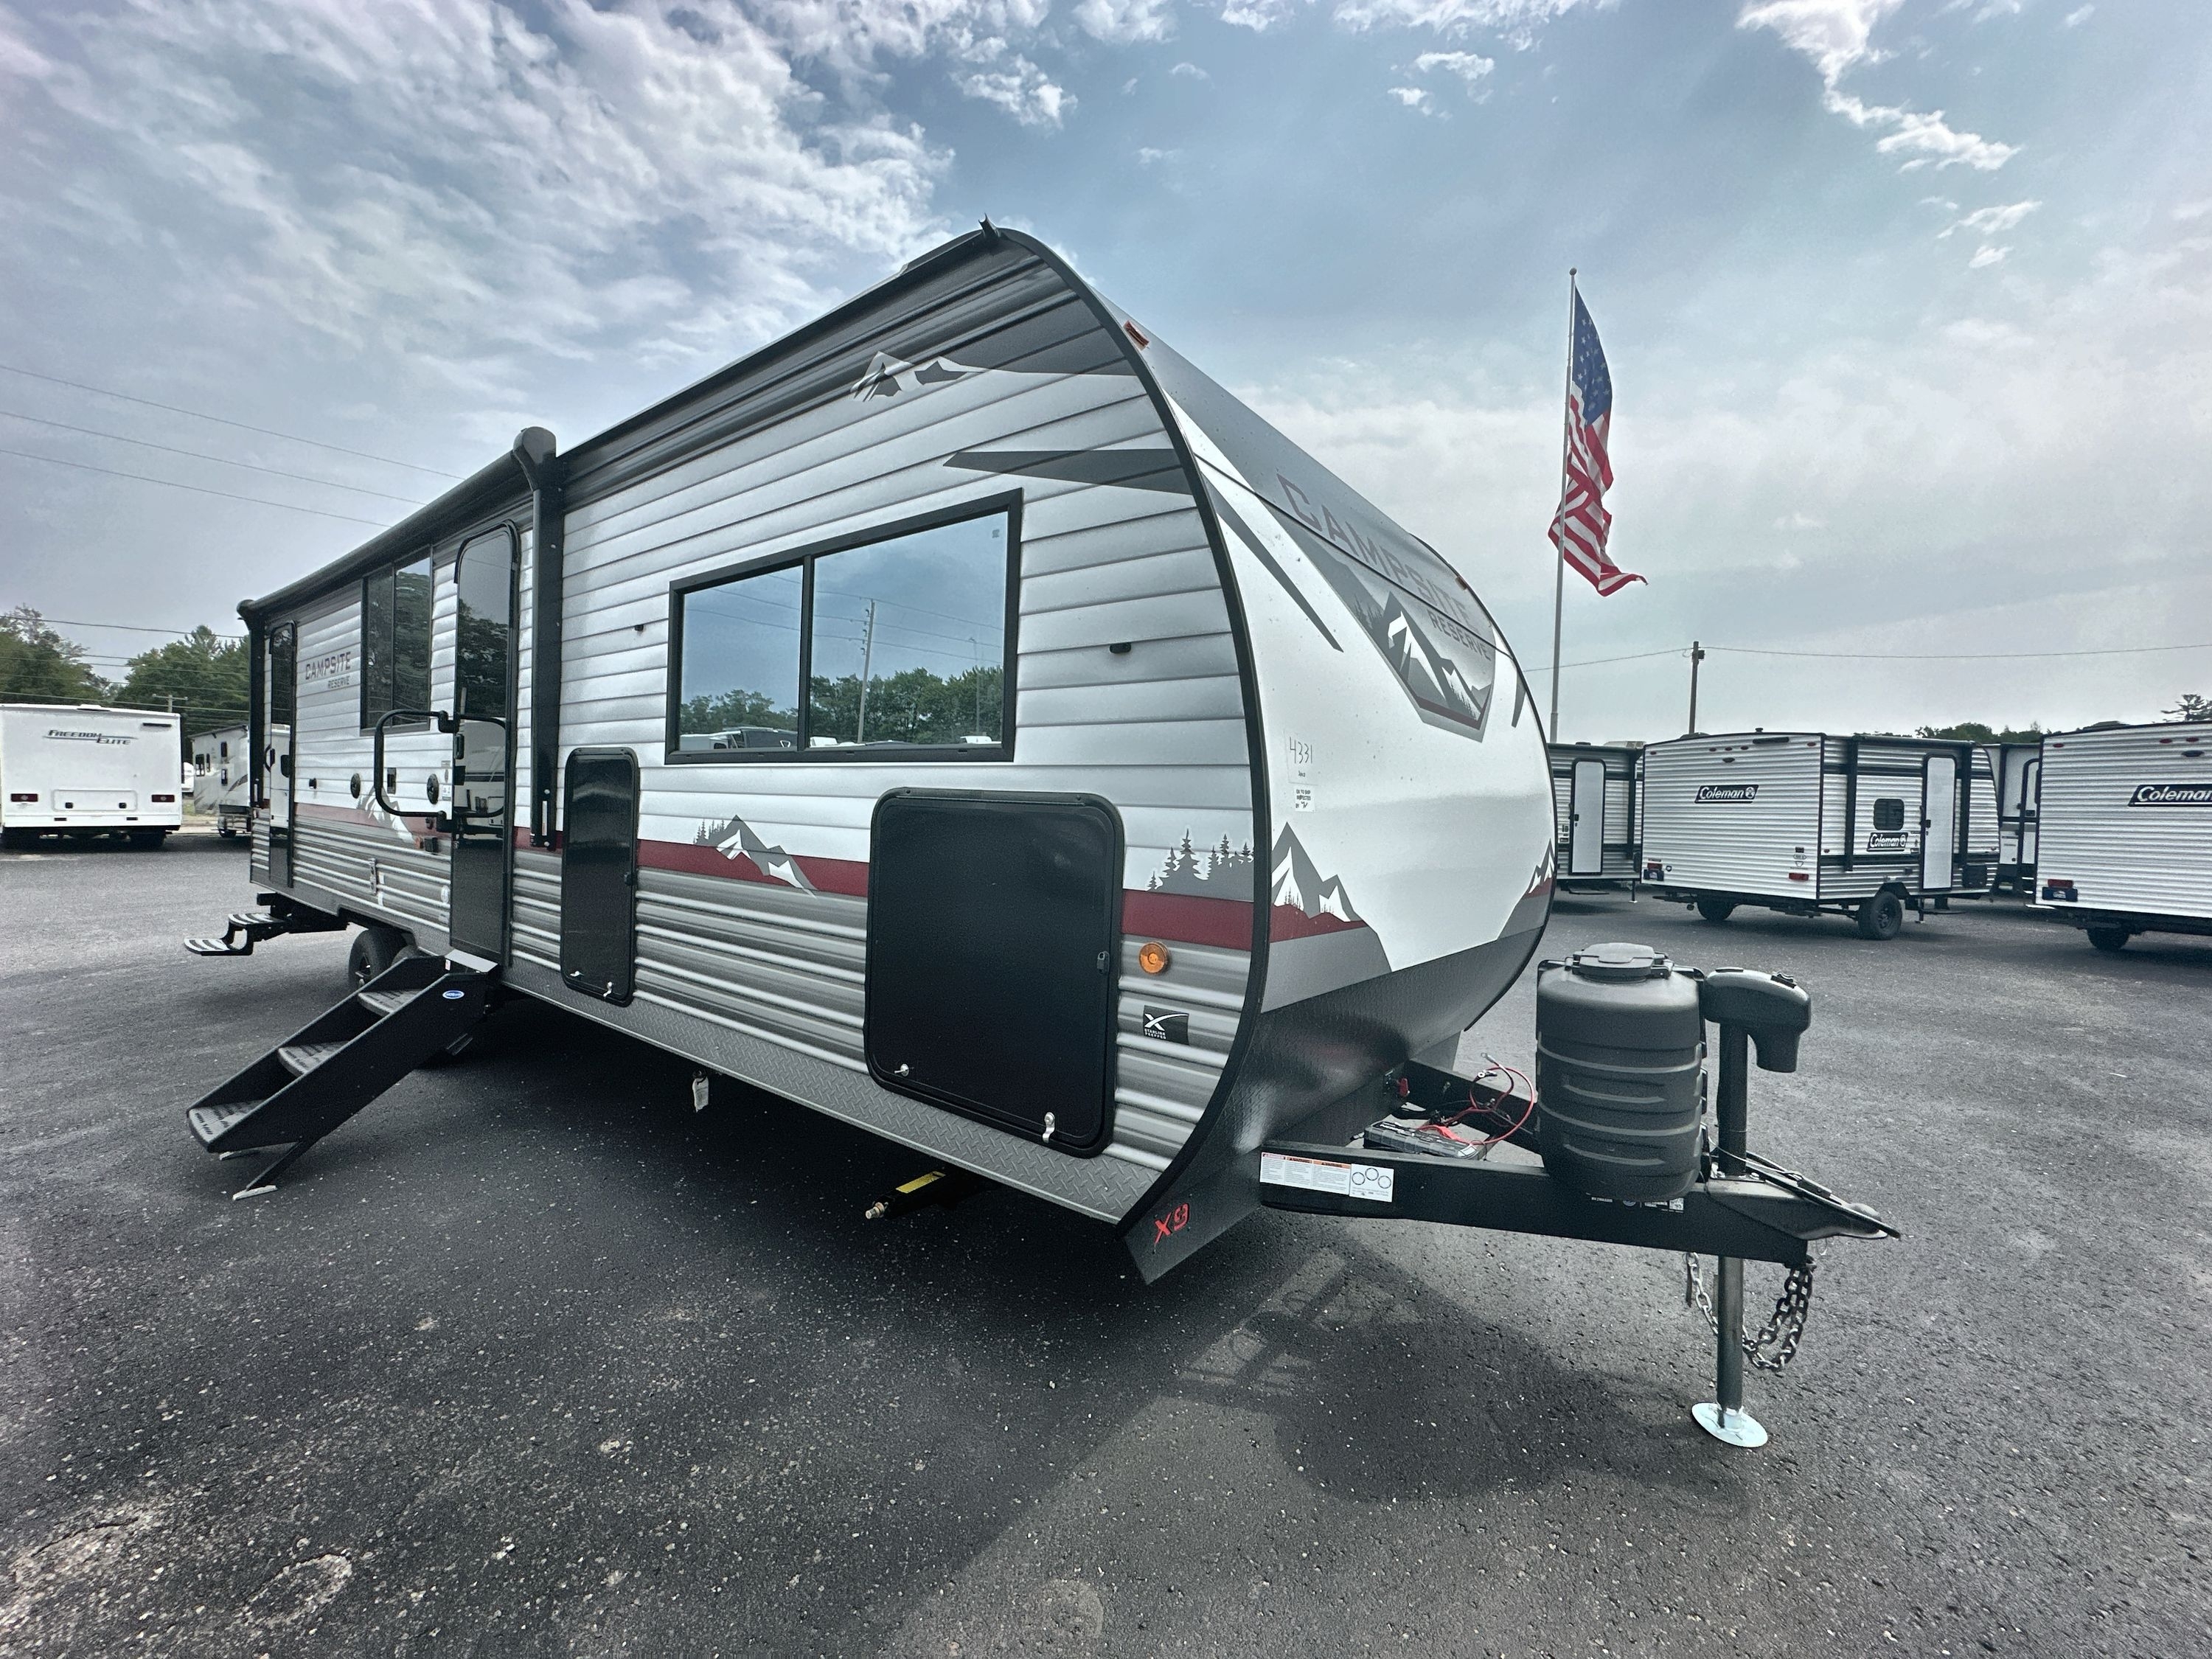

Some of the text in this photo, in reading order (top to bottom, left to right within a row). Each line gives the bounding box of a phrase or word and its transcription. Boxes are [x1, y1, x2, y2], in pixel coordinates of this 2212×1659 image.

[1276, 473, 1482, 636] CAMPSITE
[1427, 608, 1492, 661] RESERVE
[305, 651, 351, 680] CAMPSITE
[1289, 737, 1312, 764] 4331
[1700, 786, 1745, 799] Coleman
[1869, 833, 1899, 848] Coleman
